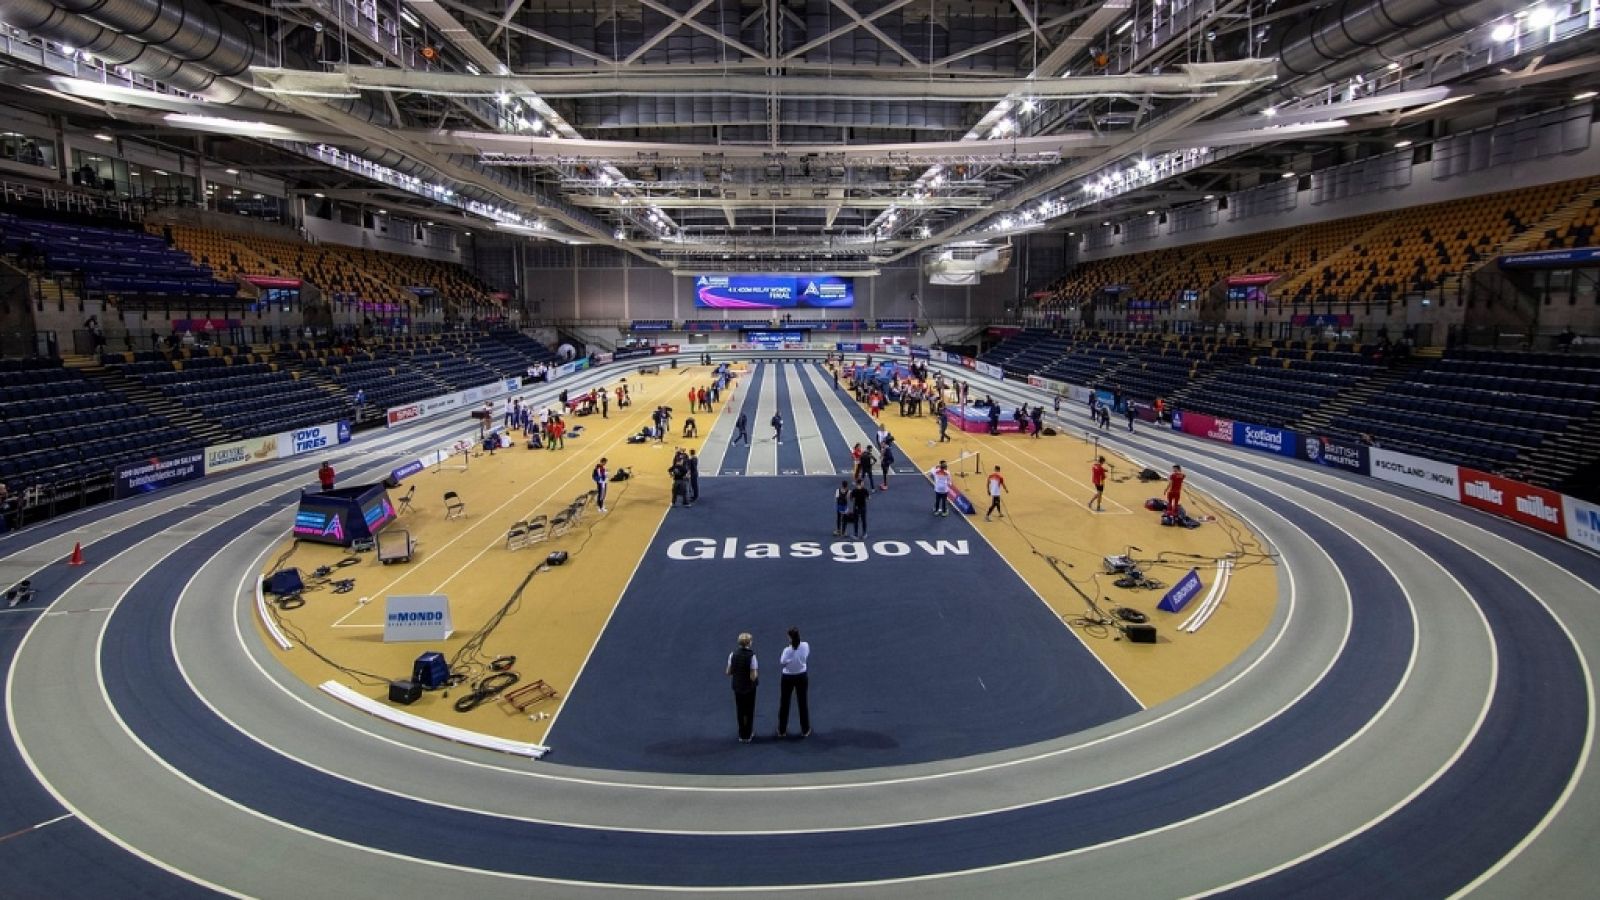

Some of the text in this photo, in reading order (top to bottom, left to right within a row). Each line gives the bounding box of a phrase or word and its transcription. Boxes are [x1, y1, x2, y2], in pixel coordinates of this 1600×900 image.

[1245, 426, 1282, 444] Scotland
[297, 436, 328, 451] TIRES
[1324, 443, 1359, 458] BRITISH
[1324, 454, 1360, 468] ATHLETICS
[666, 537, 970, 562] Glasgow
[398, 610, 443, 622] MONDO
